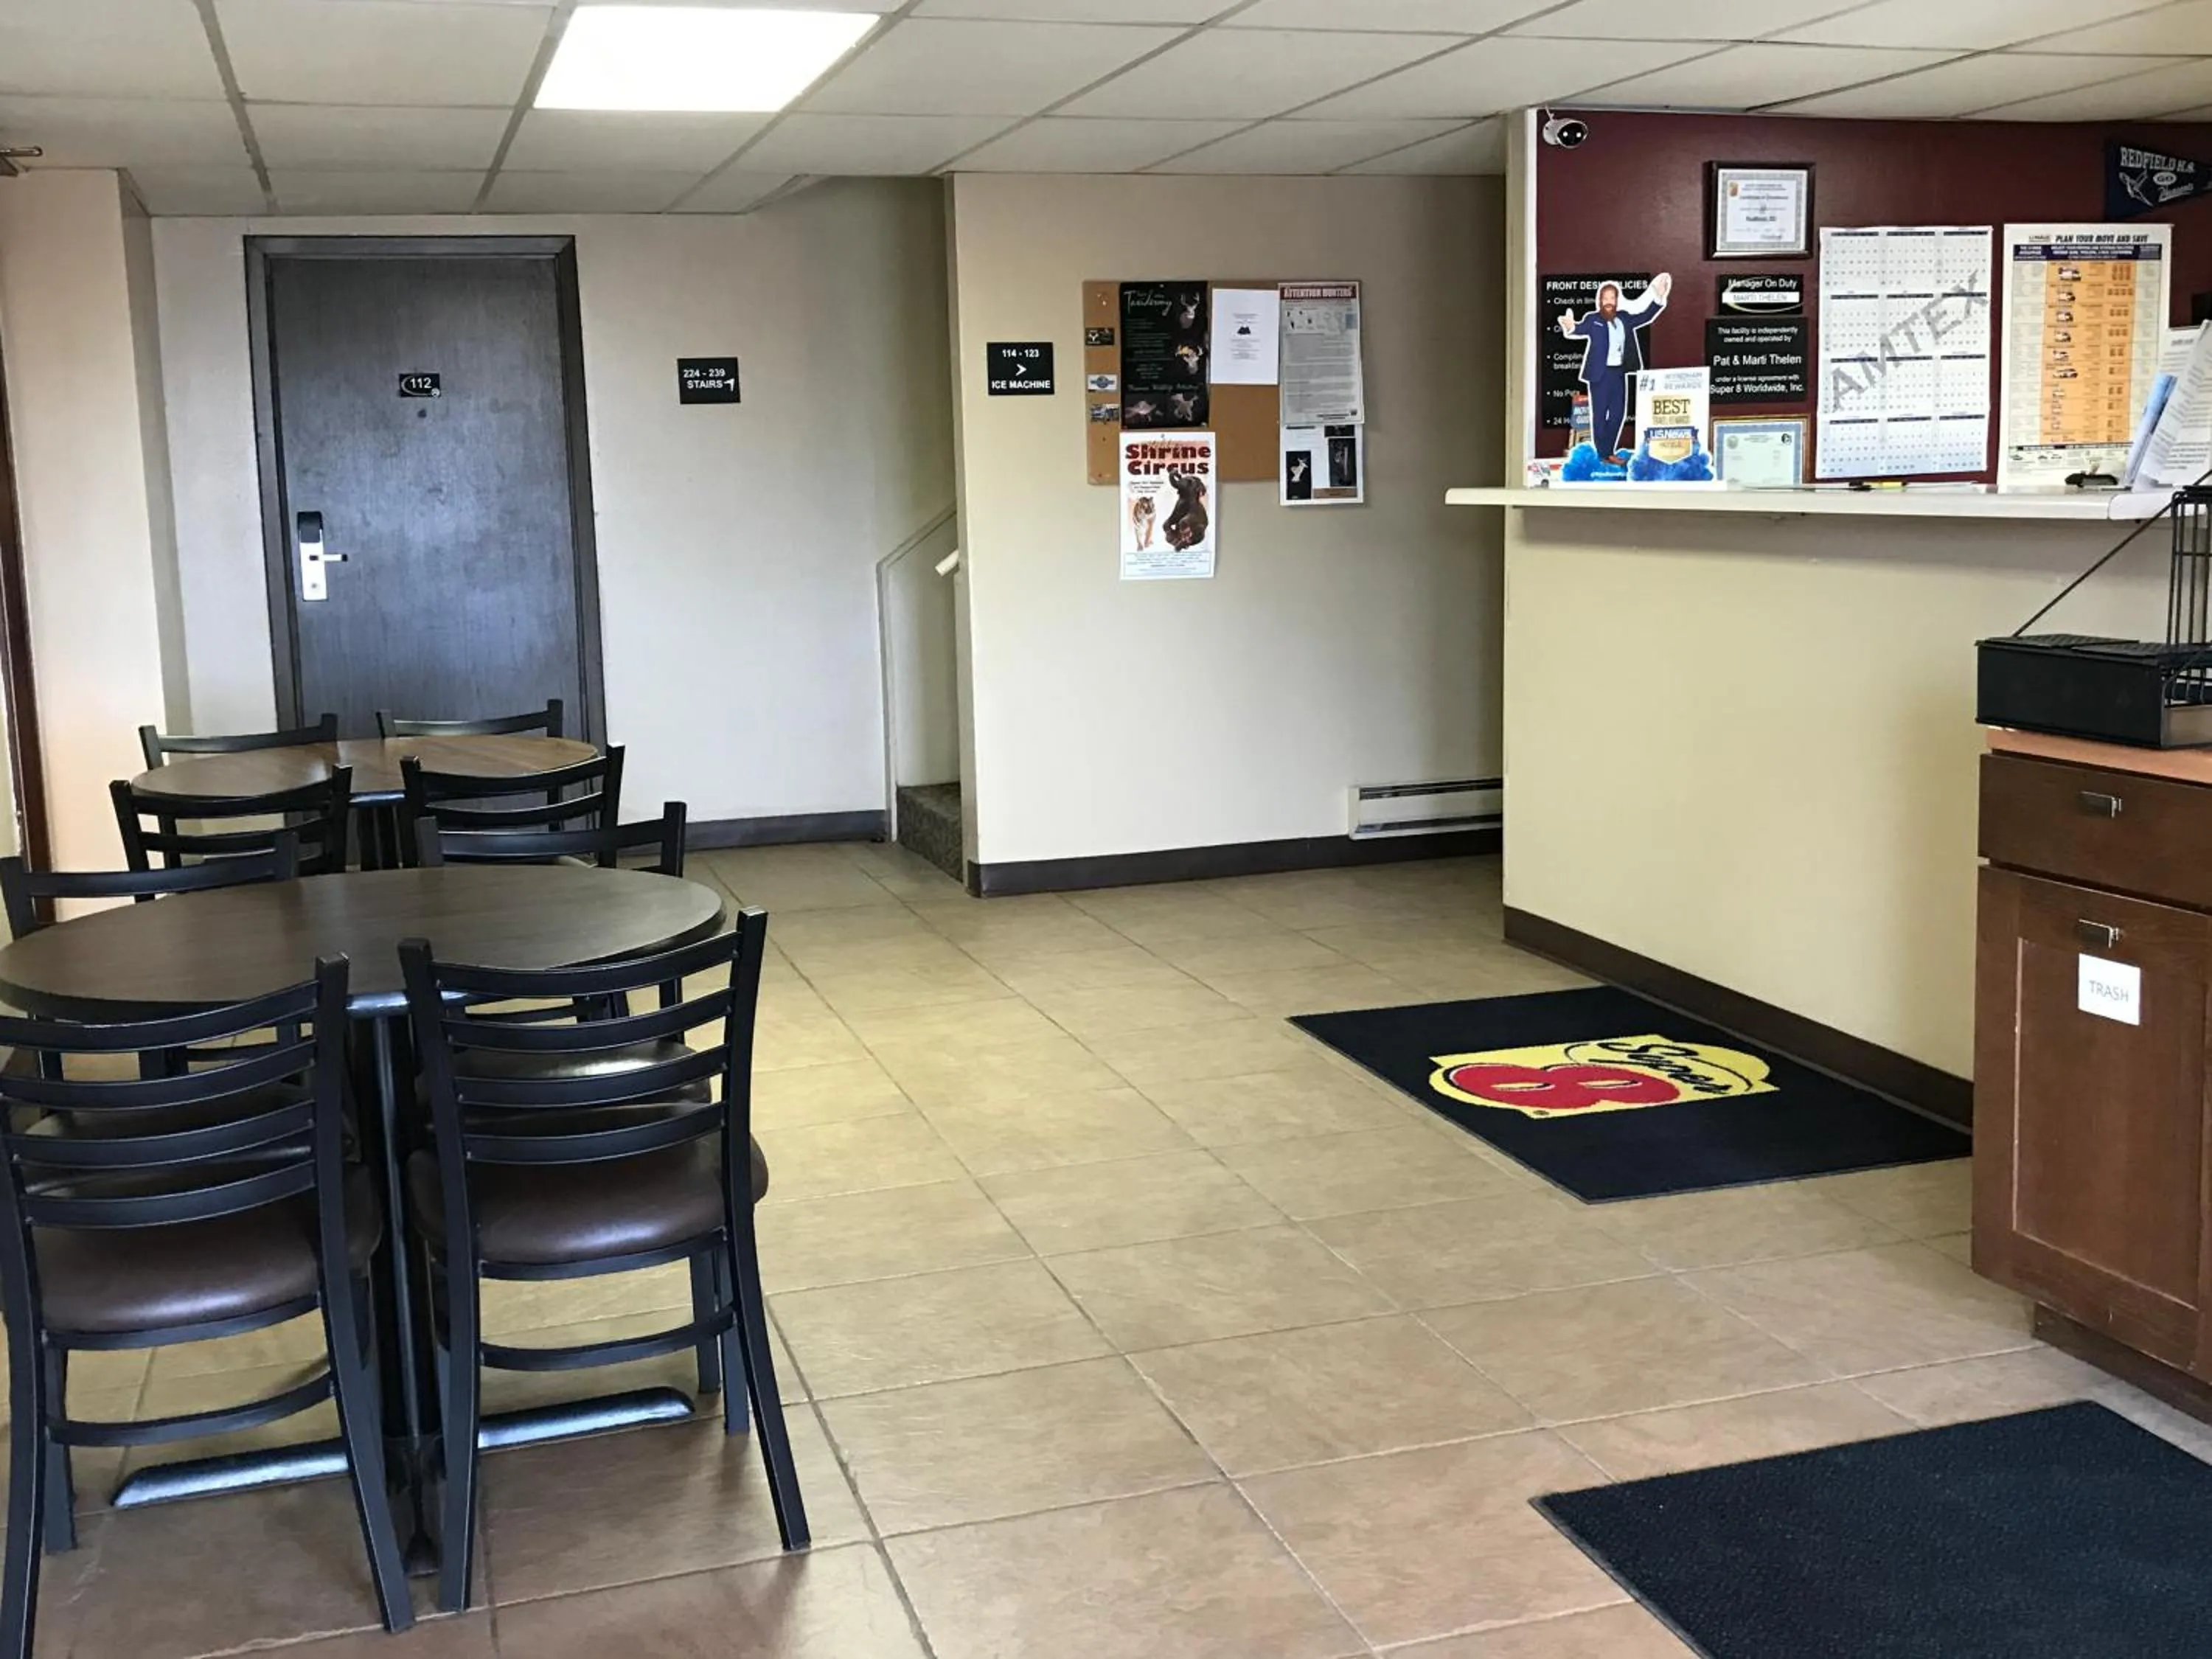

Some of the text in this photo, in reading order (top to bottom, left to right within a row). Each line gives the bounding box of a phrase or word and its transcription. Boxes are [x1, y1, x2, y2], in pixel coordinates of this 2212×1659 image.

[2120, 146, 2176, 170] REDFIELD
[1546, 281, 1578, 291] FRONT
[1728, 279, 1798, 289] Manager On Duty
[1758, 327, 1798, 335] independently
[1830, 269, 1989, 412] AMTEX
[1002, 349, 1017, 358] 114
[1025, 349, 1040, 358] 123
[1713, 354, 1801, 366] Pat & Marti Thelen
[709, 368, 726, 377] 239
[410, 378, 432, 389] 112
[686, 380, 723, 389] STAIRS
[991, 380, 1051, 389] ICE MACHINE
[1639, 375, 1656, 392] #1
[1710, 385, 1734, 395] Super
[1790, 383, 1804, 392] Inc.
[1652, 399, 1691, 415] BEST
[1125, 444, 1211, 459] Shrine
[1127, 460, 1209, 475] Circus
[2089, 980, 2129, 1003] TRASH
[1588, 1042, 1732, 1094] Super
